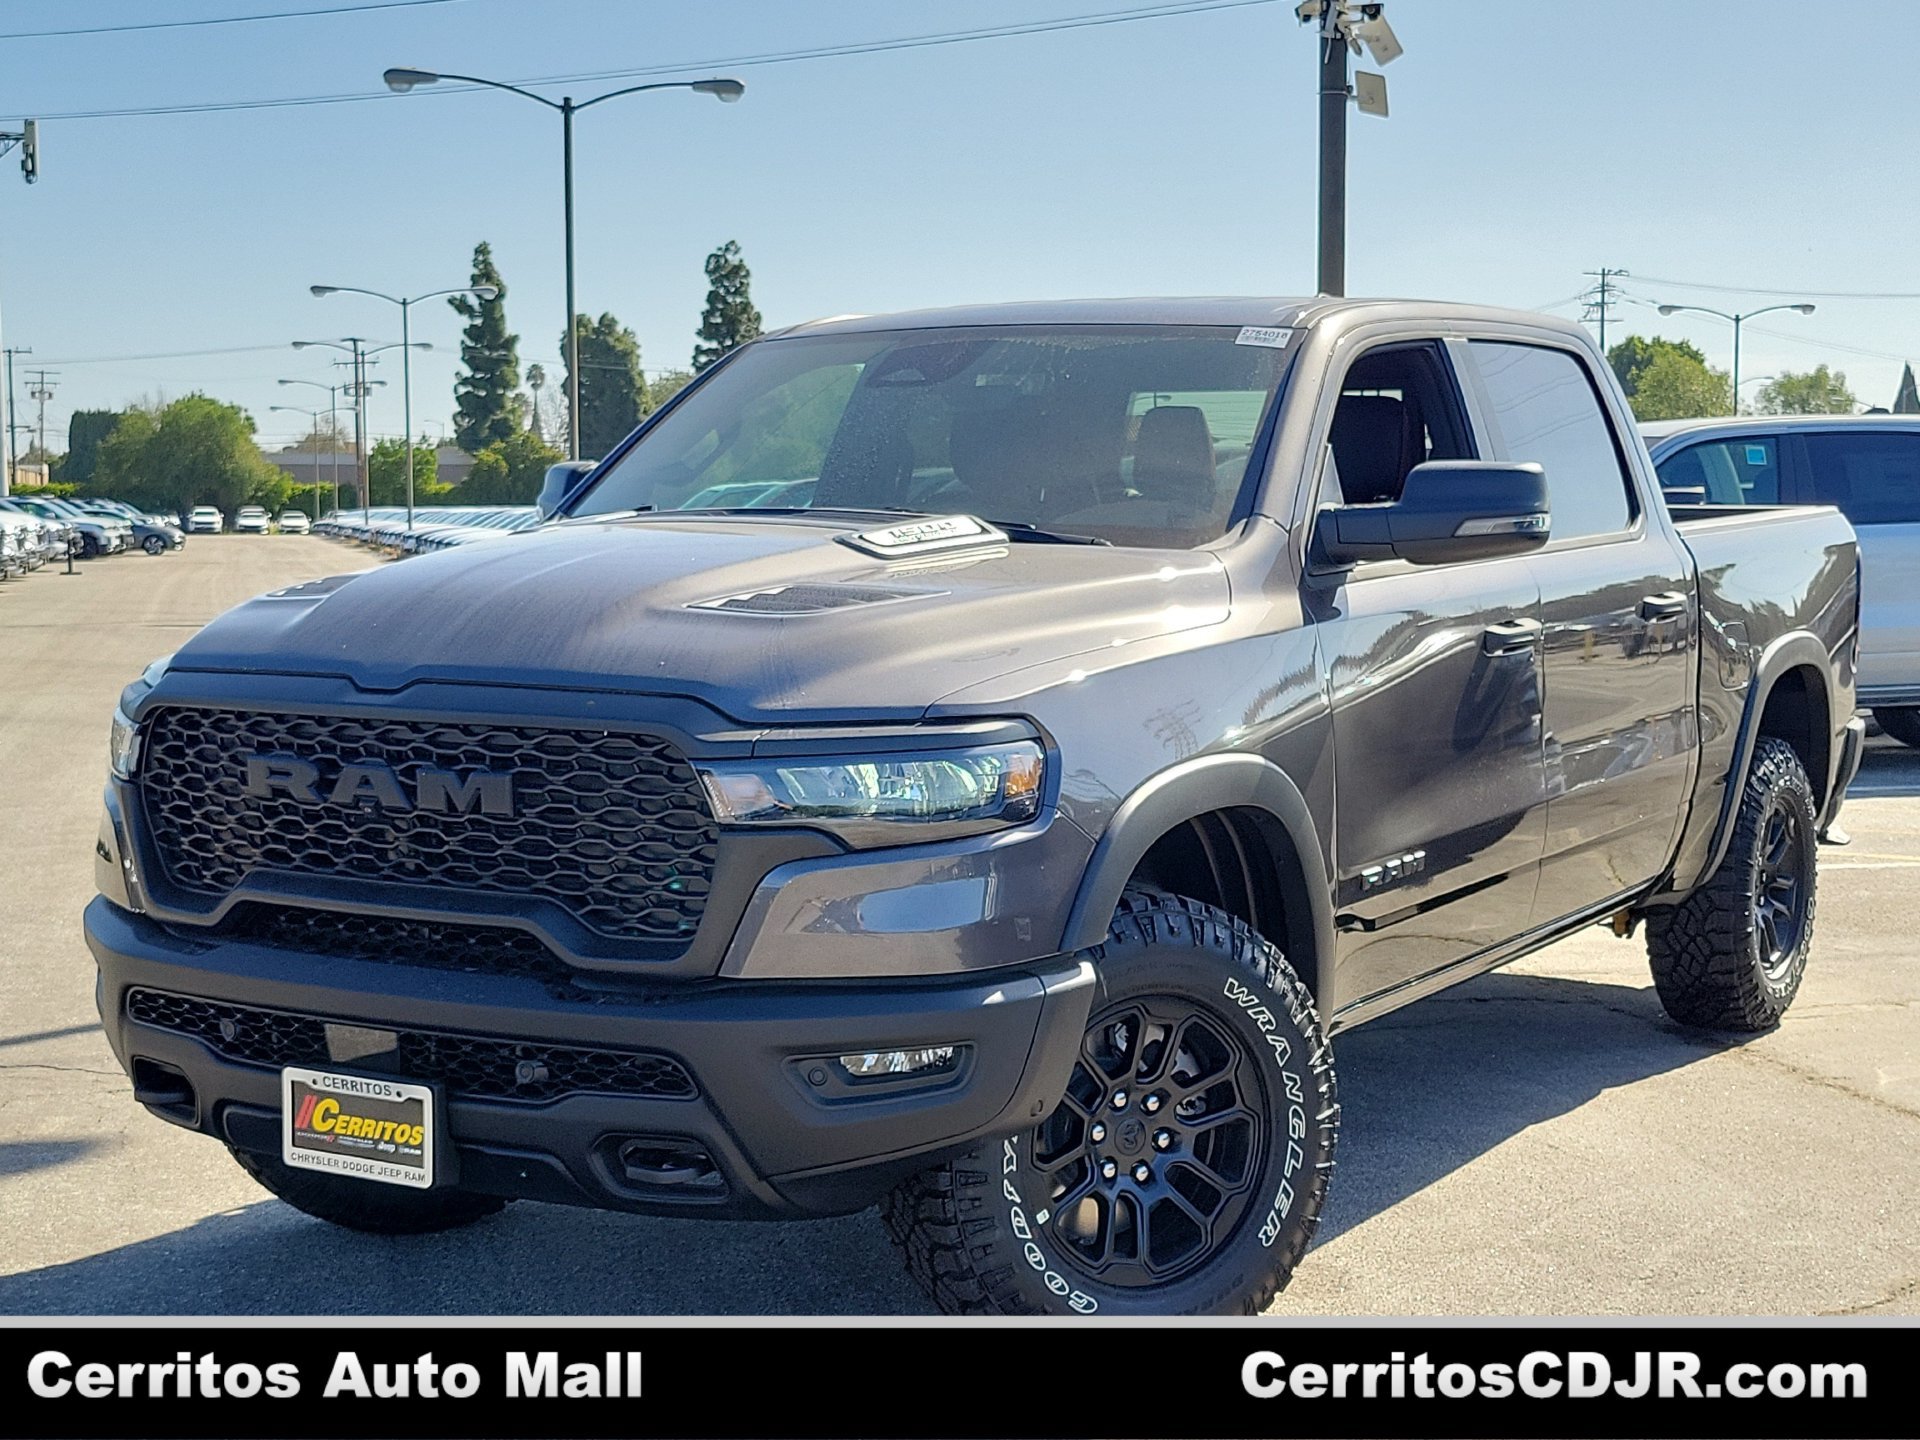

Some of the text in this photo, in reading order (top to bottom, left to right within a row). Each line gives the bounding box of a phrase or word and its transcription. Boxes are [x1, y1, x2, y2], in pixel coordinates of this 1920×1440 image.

[245, 752, 514, 817] RAM
[322, 1075, 392, 1097] CERRITOS
[1223, 976, 1307, 1248] WRANGLER
[290, 1152, 426, 1182] CHRYSLER DODGE JEEP RAM
